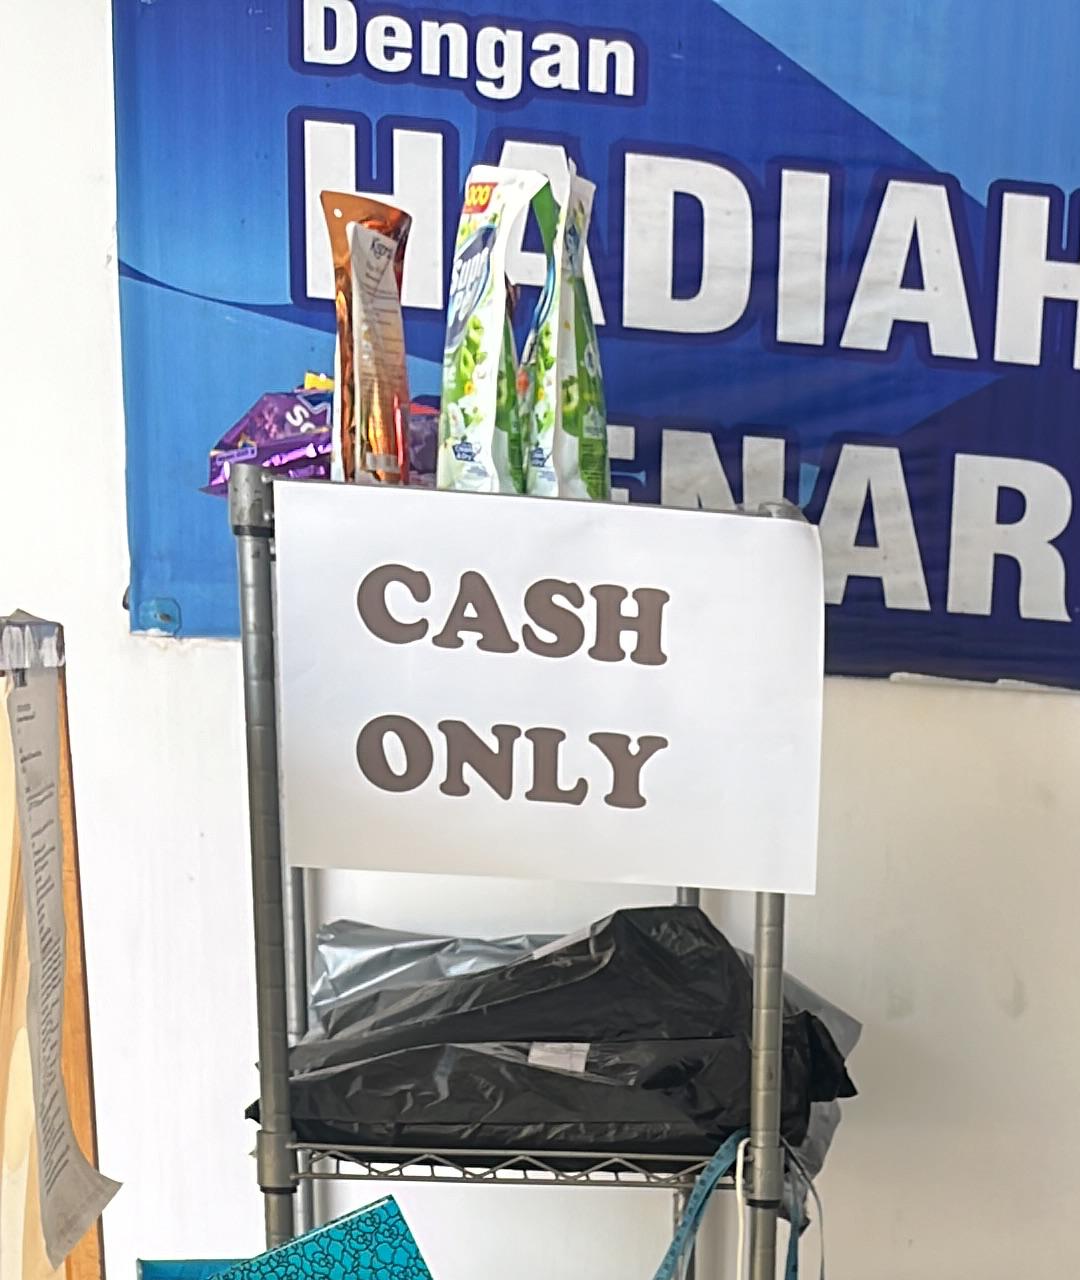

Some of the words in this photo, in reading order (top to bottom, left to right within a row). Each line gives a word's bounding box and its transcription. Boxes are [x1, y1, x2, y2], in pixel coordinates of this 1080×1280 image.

[303, 0, 636, 99] Dengan
[357, 563, 671, 667] CASH
[357, 714, 669, 809] ONLY
